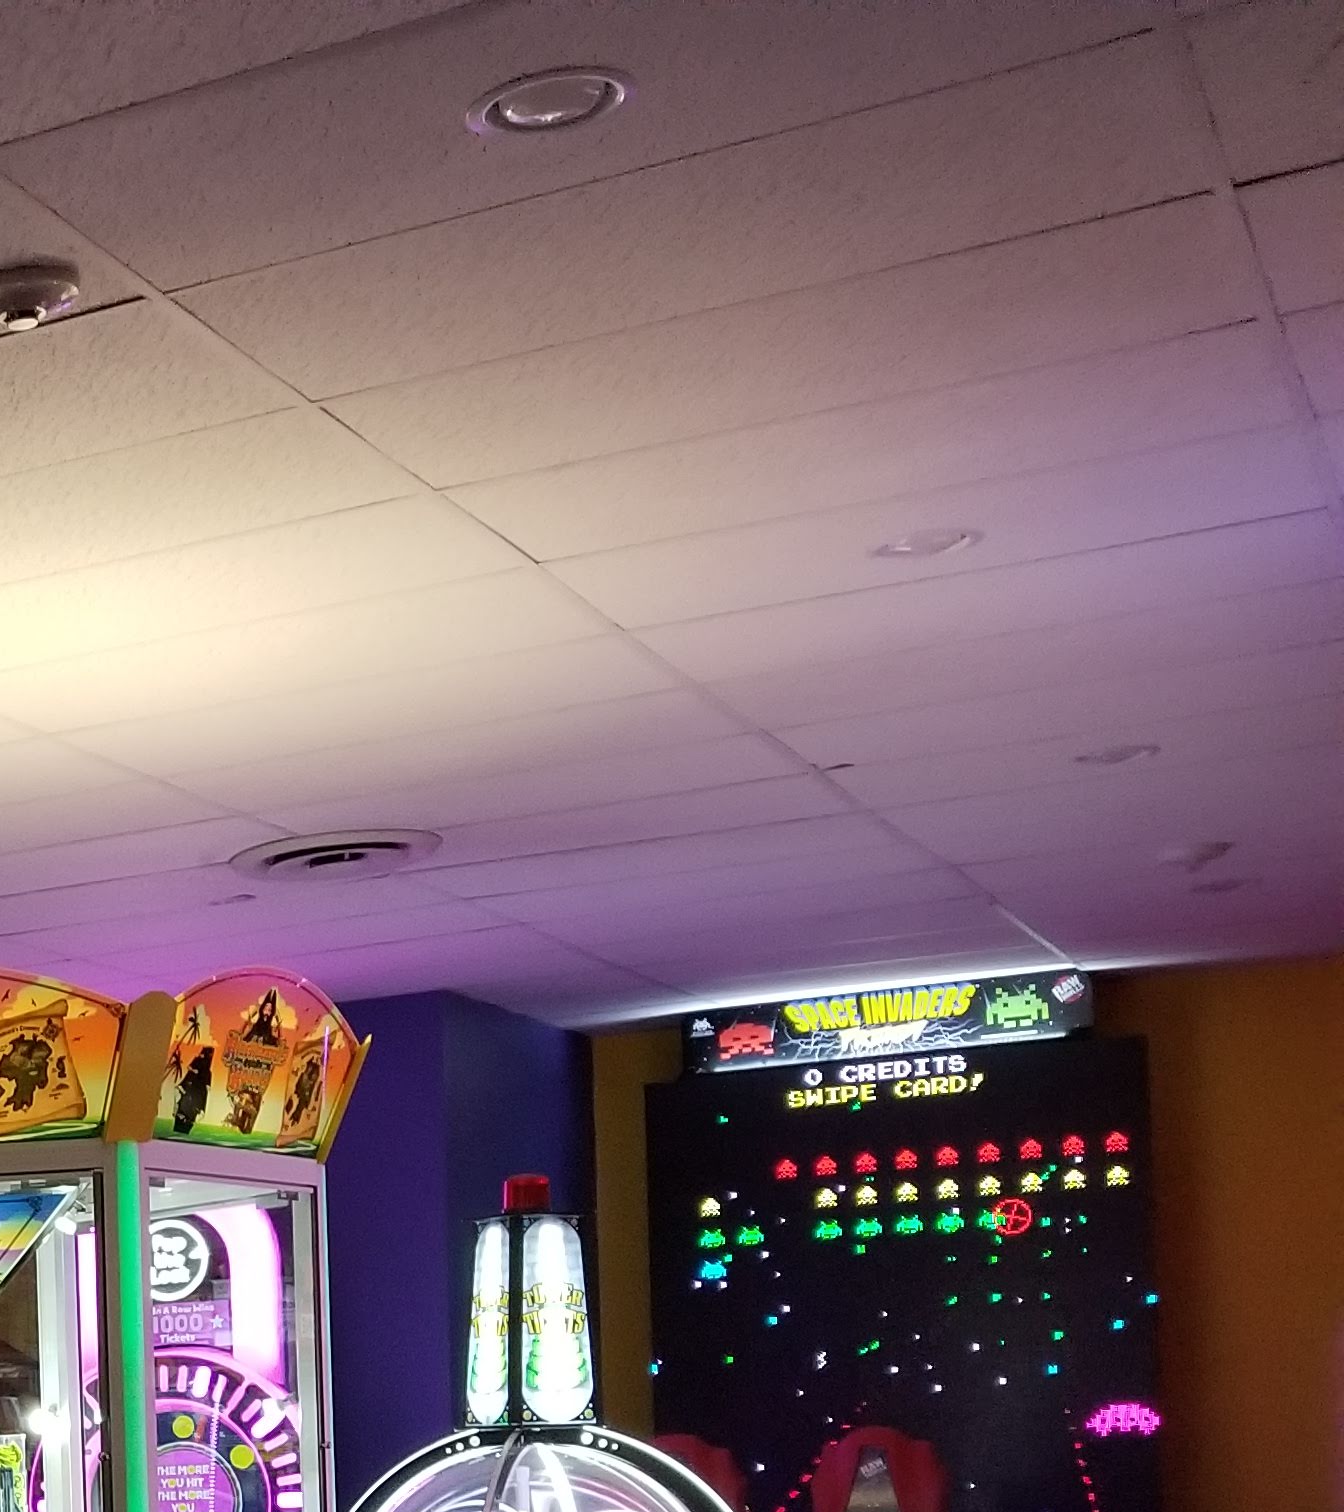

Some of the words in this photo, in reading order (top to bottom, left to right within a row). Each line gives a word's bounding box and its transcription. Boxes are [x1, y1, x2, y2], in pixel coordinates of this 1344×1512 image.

[783, 994, 861, 1033] SPACE
[862, 983, 977, 1026] INVADERS
[839, 1054, 967, 1084] CREDITS
[788, 1083, 877, 1109] SWIPE
[894, 1072, 984, 1099] CARD!
[159, 1333, 196, 1344] Tickets
[177, 1465, 210, 1475] MORE
[161, 1478, 184, 1488] YOU
[186, 1478, 204, 1488] HIT
[179, 1490, 212, 1500] MORE
[171, 1503, 195, 1512] YOU
